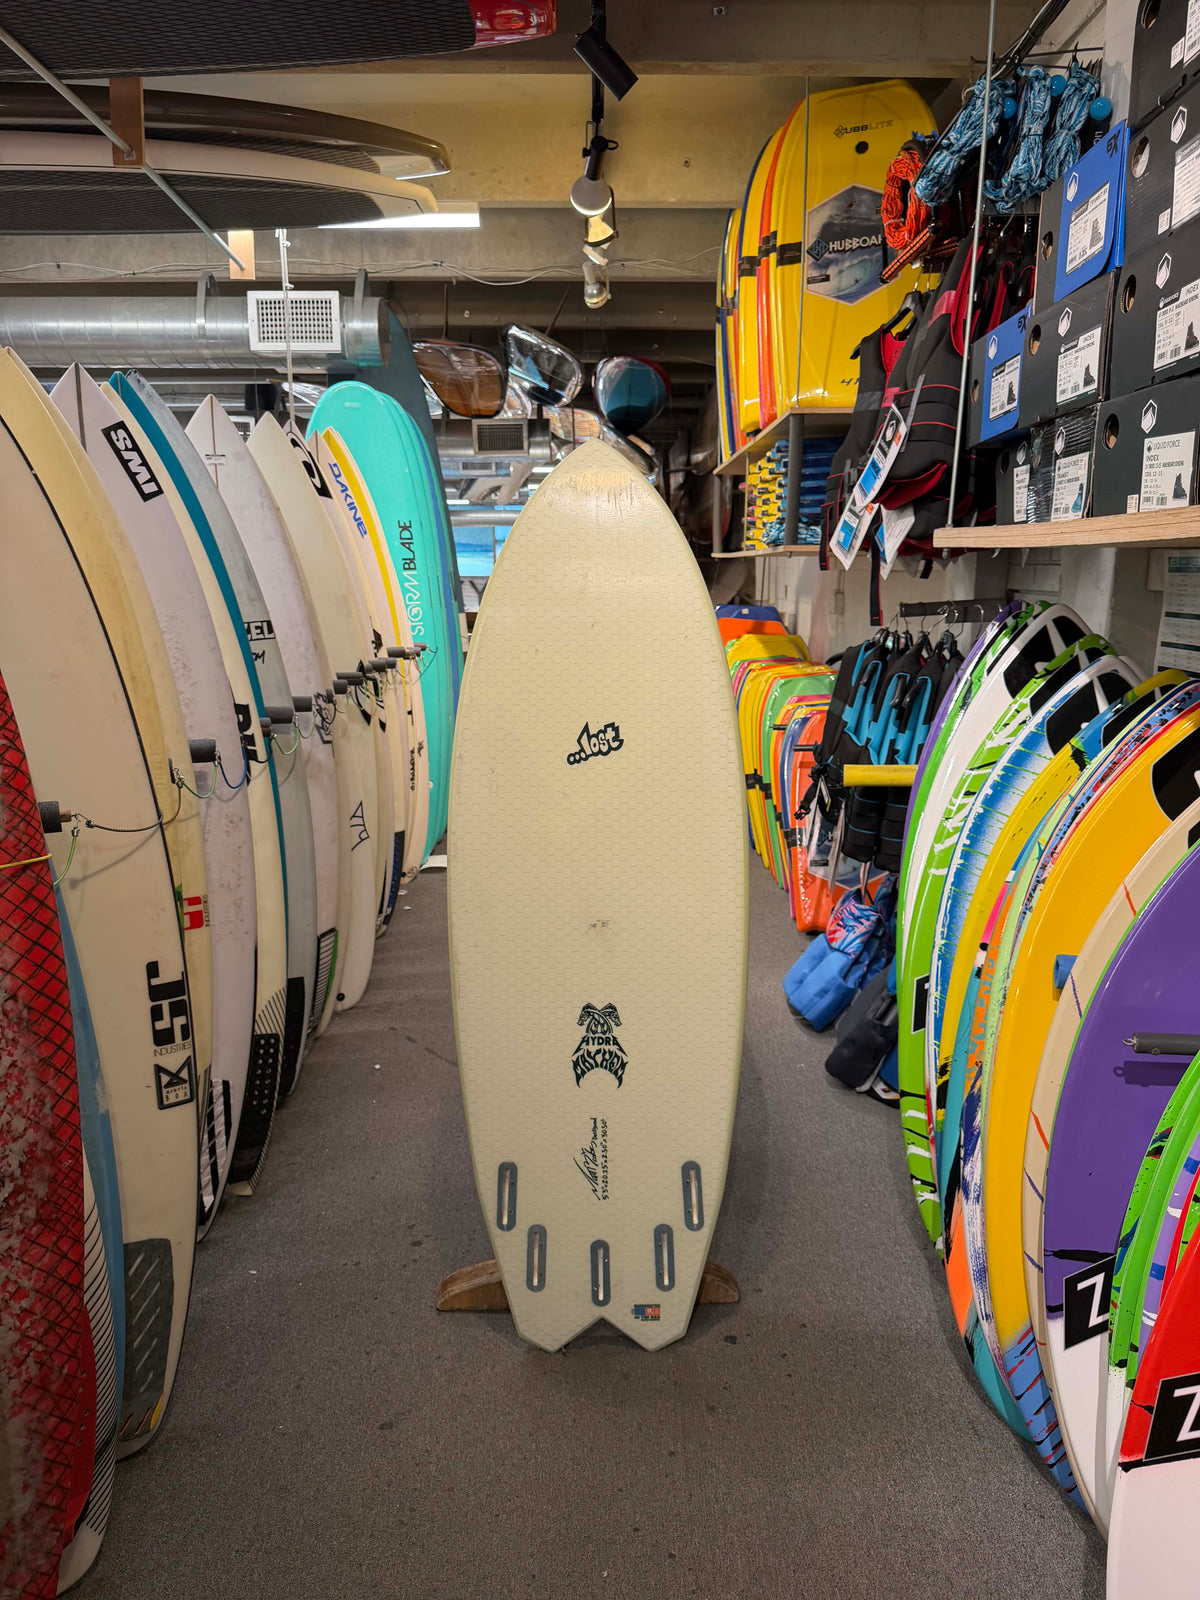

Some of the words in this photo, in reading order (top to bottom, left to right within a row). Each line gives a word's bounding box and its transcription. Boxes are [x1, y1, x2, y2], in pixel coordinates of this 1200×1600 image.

[110, 428, 159, 494] SMI
[1145, 454, 1160, 462] INDEX
[328, 462, 368, 539] DAKINE
[146, 960, 191, 1047] JS
[153, 1041, 192, 1057] INDUSTRIES
